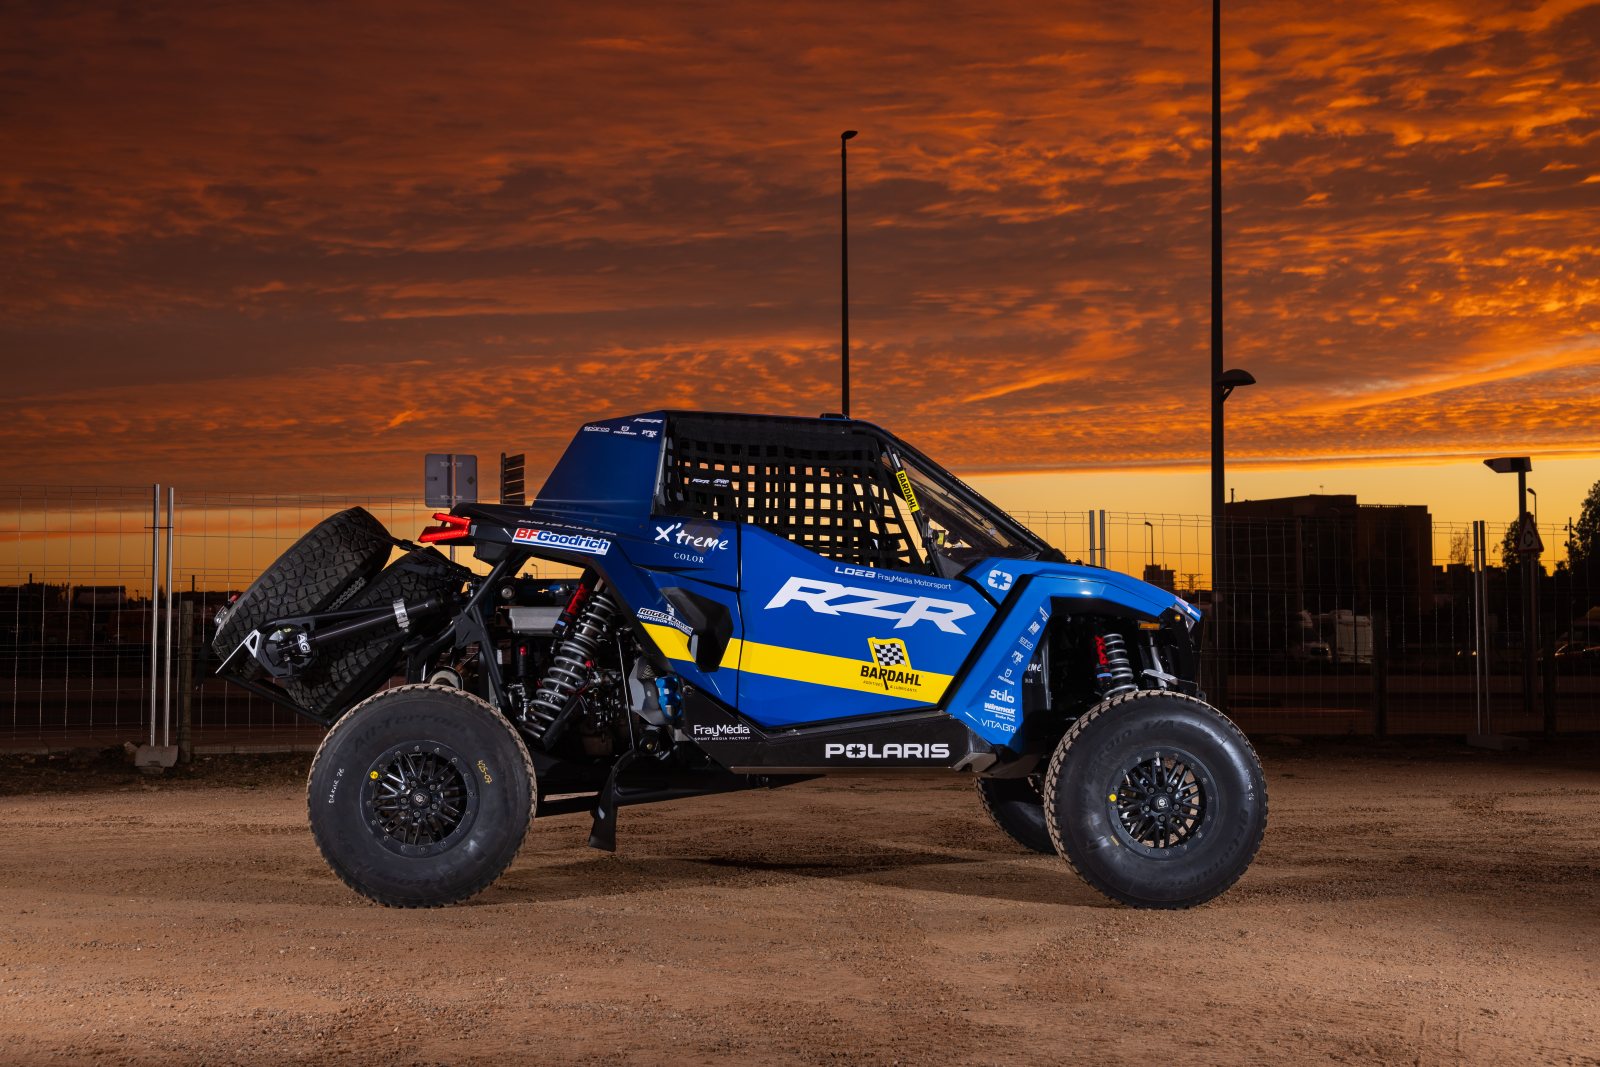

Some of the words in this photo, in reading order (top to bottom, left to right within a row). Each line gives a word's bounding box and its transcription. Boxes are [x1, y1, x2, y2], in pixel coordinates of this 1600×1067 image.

[898, 472, 917, 511] BARDAHL
[515, 528, 609, 550] BFGoodrich
[654, 522, 729, 551] X'treme
[673, 552, 704, 564] COLOR
[835, 566, 876, 578] LOEB
[877, 573, 913, 584] FrayMédia
[914, 578, 952, 591] Motorsport
[764, 576, 976, 636] RZR
[860, 665, 922, 687] BARDAHL
[989, 689, 1015, 704] Stilo
[984, 702, 1016, 715] Winmax
[693, 723, 751, 737] FrayMédia
[981, 718, 1017, 733] VITABRI
[825, 743, 950, 759] POLARIS
